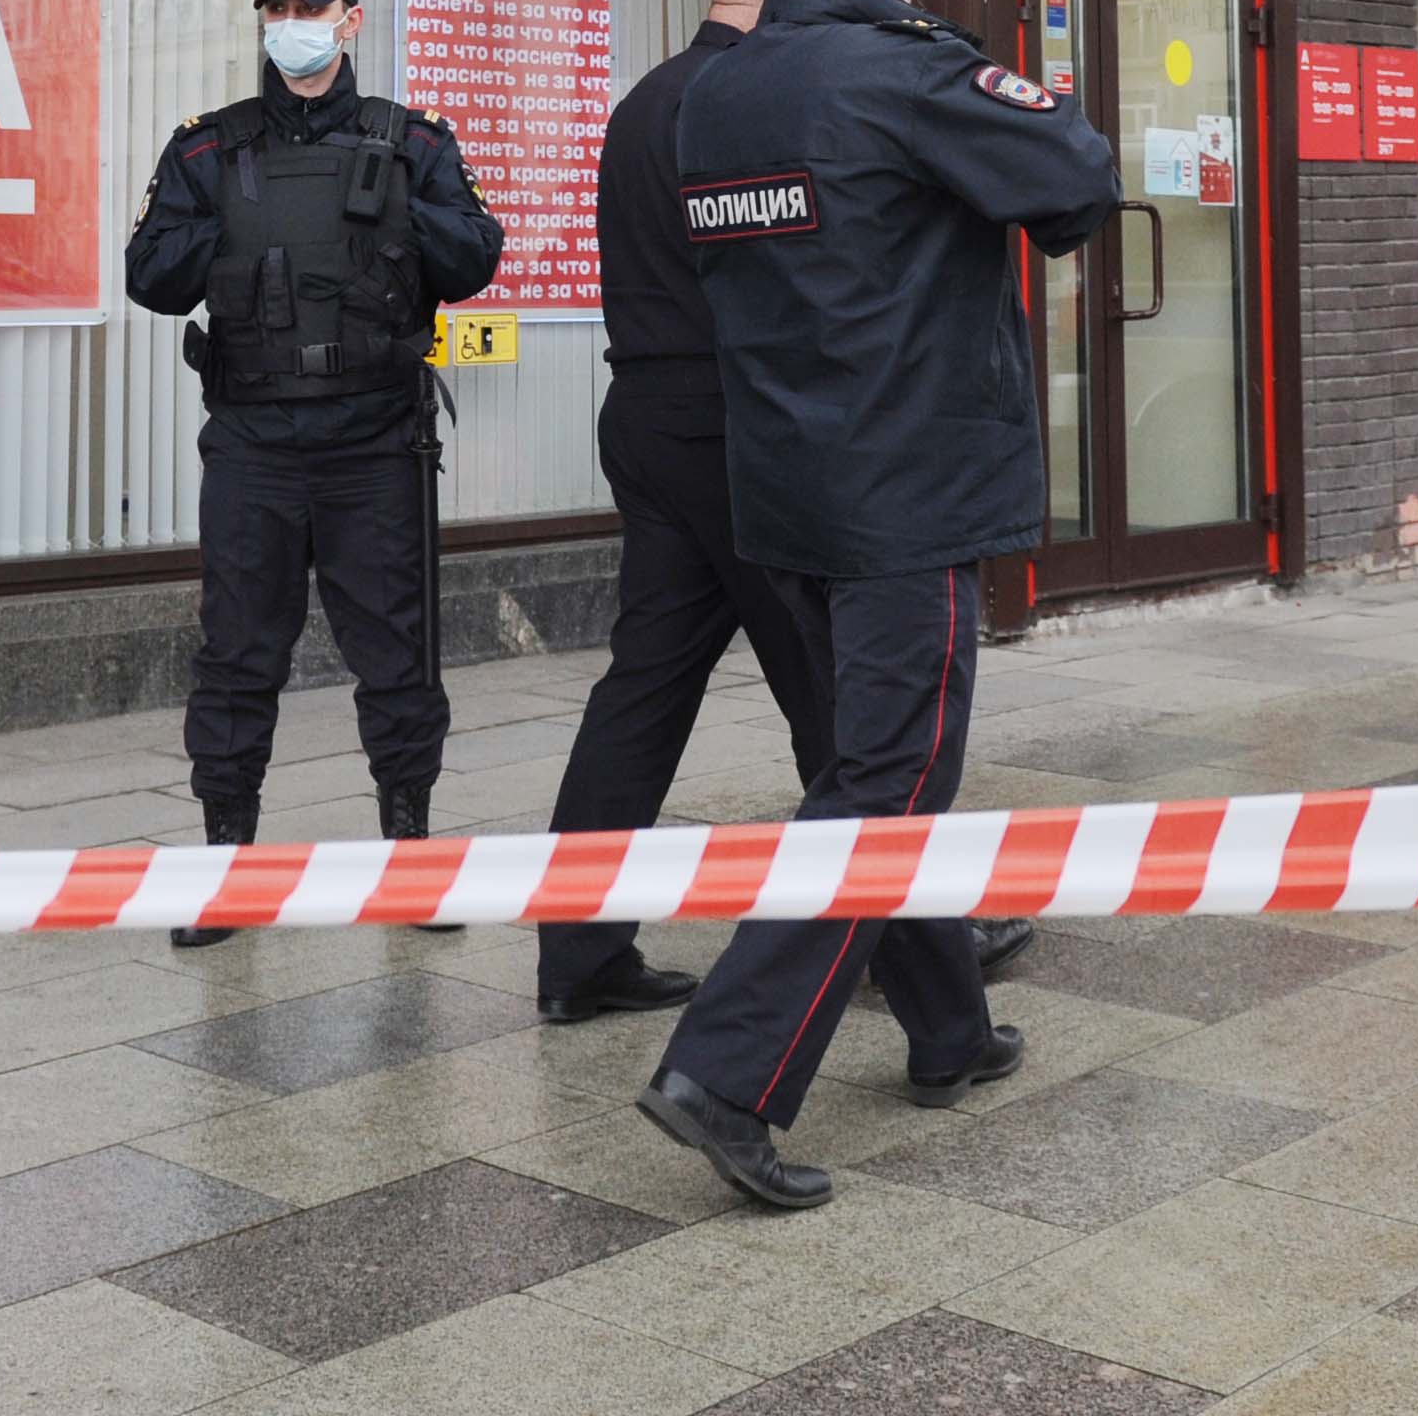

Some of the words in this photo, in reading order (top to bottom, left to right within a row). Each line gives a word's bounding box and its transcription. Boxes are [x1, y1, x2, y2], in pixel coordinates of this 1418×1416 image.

[493, 1, 517, 17] не
[522, 3, 545, 19] за
[550, 6, 583, 22] что
[463, 21, 487, 37] не
[491, 24, 514, 39] за
[520, 27, 553, 42] что
[424, 42, 448, 58] за
[453, 45, 488, 61] что
[493, 47, 585, 67] краснеть
[420, 65, 516, 87] краснеть
[525, 73, 549, 88] не
[552, 74, 575, 90] за
[414, 90, 439, 105] не
[443, 92, 468, 107] за
[473, 94, 507, 109] что
[512, 95, 604, 114] краснеть
[467, 117, 492, 133] не
[496, 119, 519, 134] за
[524, 121, 558, 136] что
[534, 143, 557, 159] не
[562, 145, 585, 160] за
[552, 190, 576, 206] не
[687, 185, 808, 229] ПОЛИЦИЯ
[500, 260, 524, 275] не
[528, 260, 551, 275] за
[556, 260, 590, 275] что
[519, 284, 544, 300] не
[548, 284, 572, 299] за
